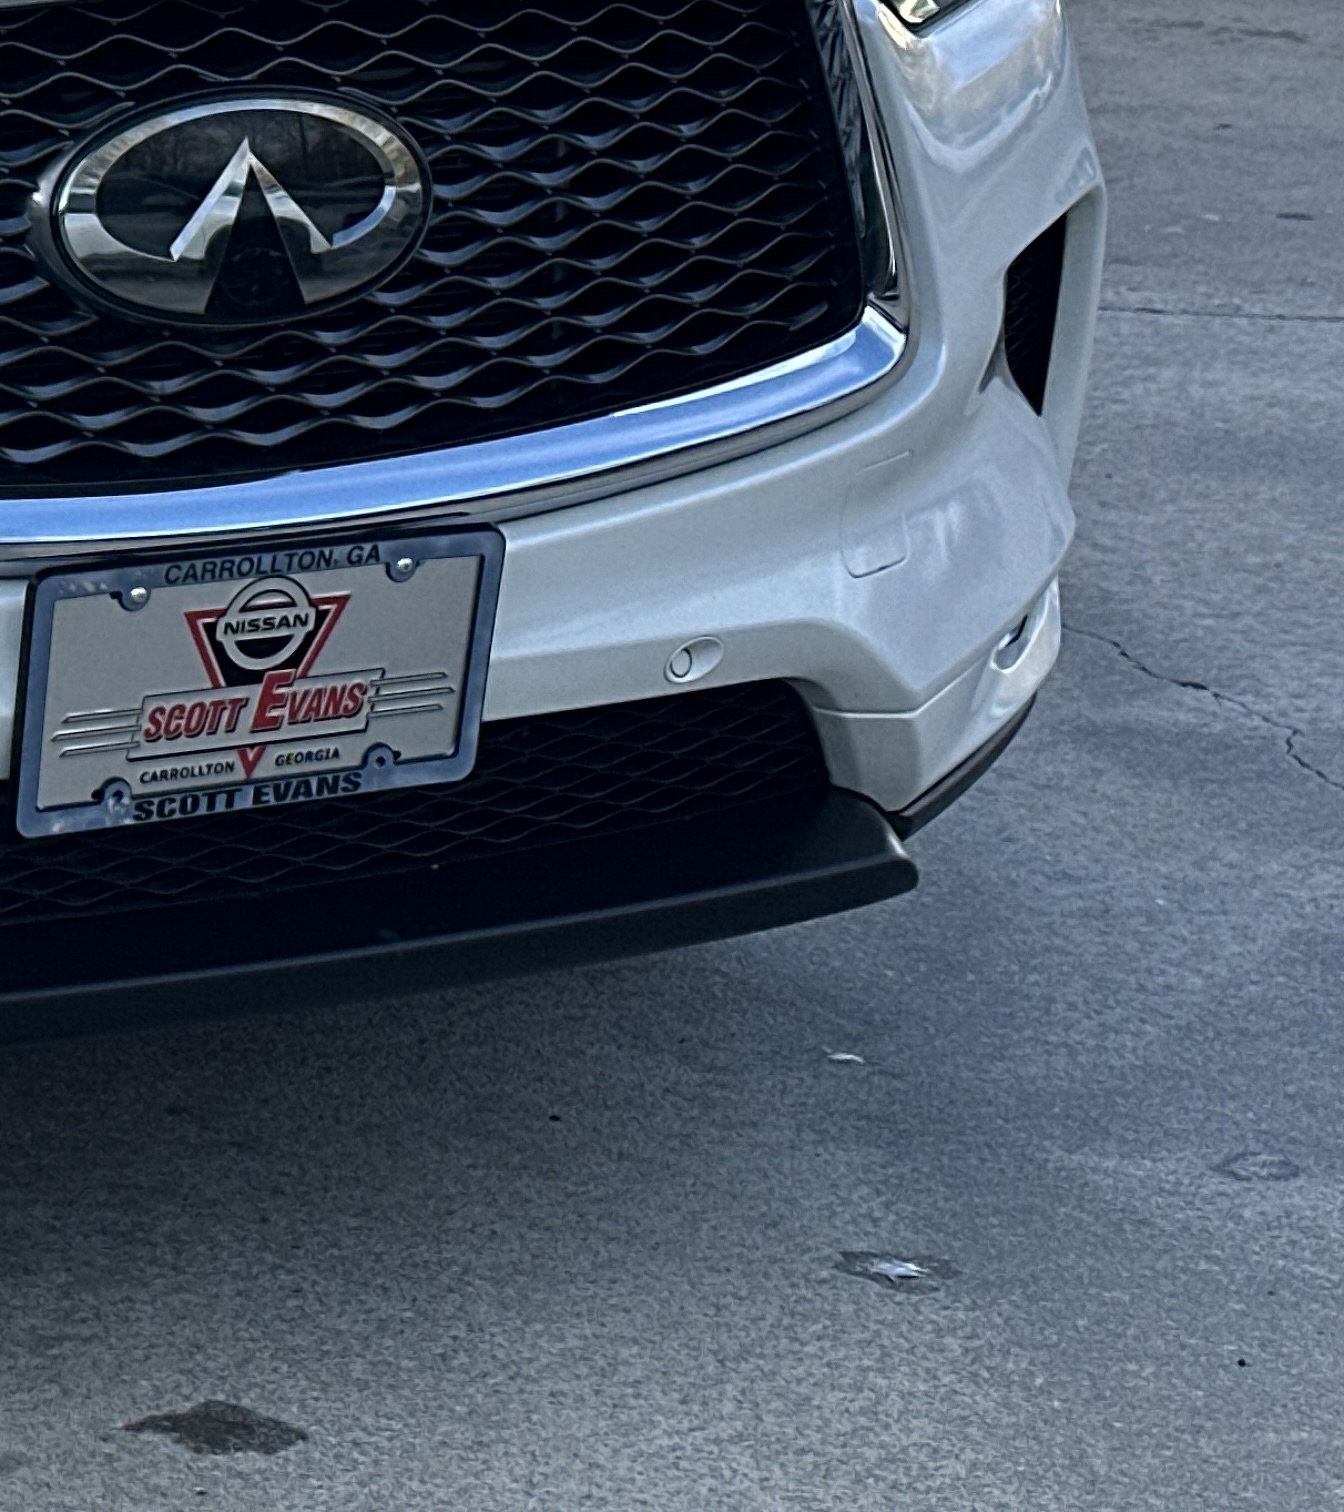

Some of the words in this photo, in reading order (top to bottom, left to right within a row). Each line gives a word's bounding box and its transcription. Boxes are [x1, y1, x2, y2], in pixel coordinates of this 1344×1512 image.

[346, 543, 381, 565] GA
[222, 612, 309, 636] NISSAN
[143, 696, 249, 743] SCOTT
[249, 668, 368, 734] EVANS
[139, 760, 236, 785] CARROLLTON
[274, 747, 341, 768] GEORGIA
[132, 786, 245, 822] SCOTT
[251, 771, 363, 806] EVANS
